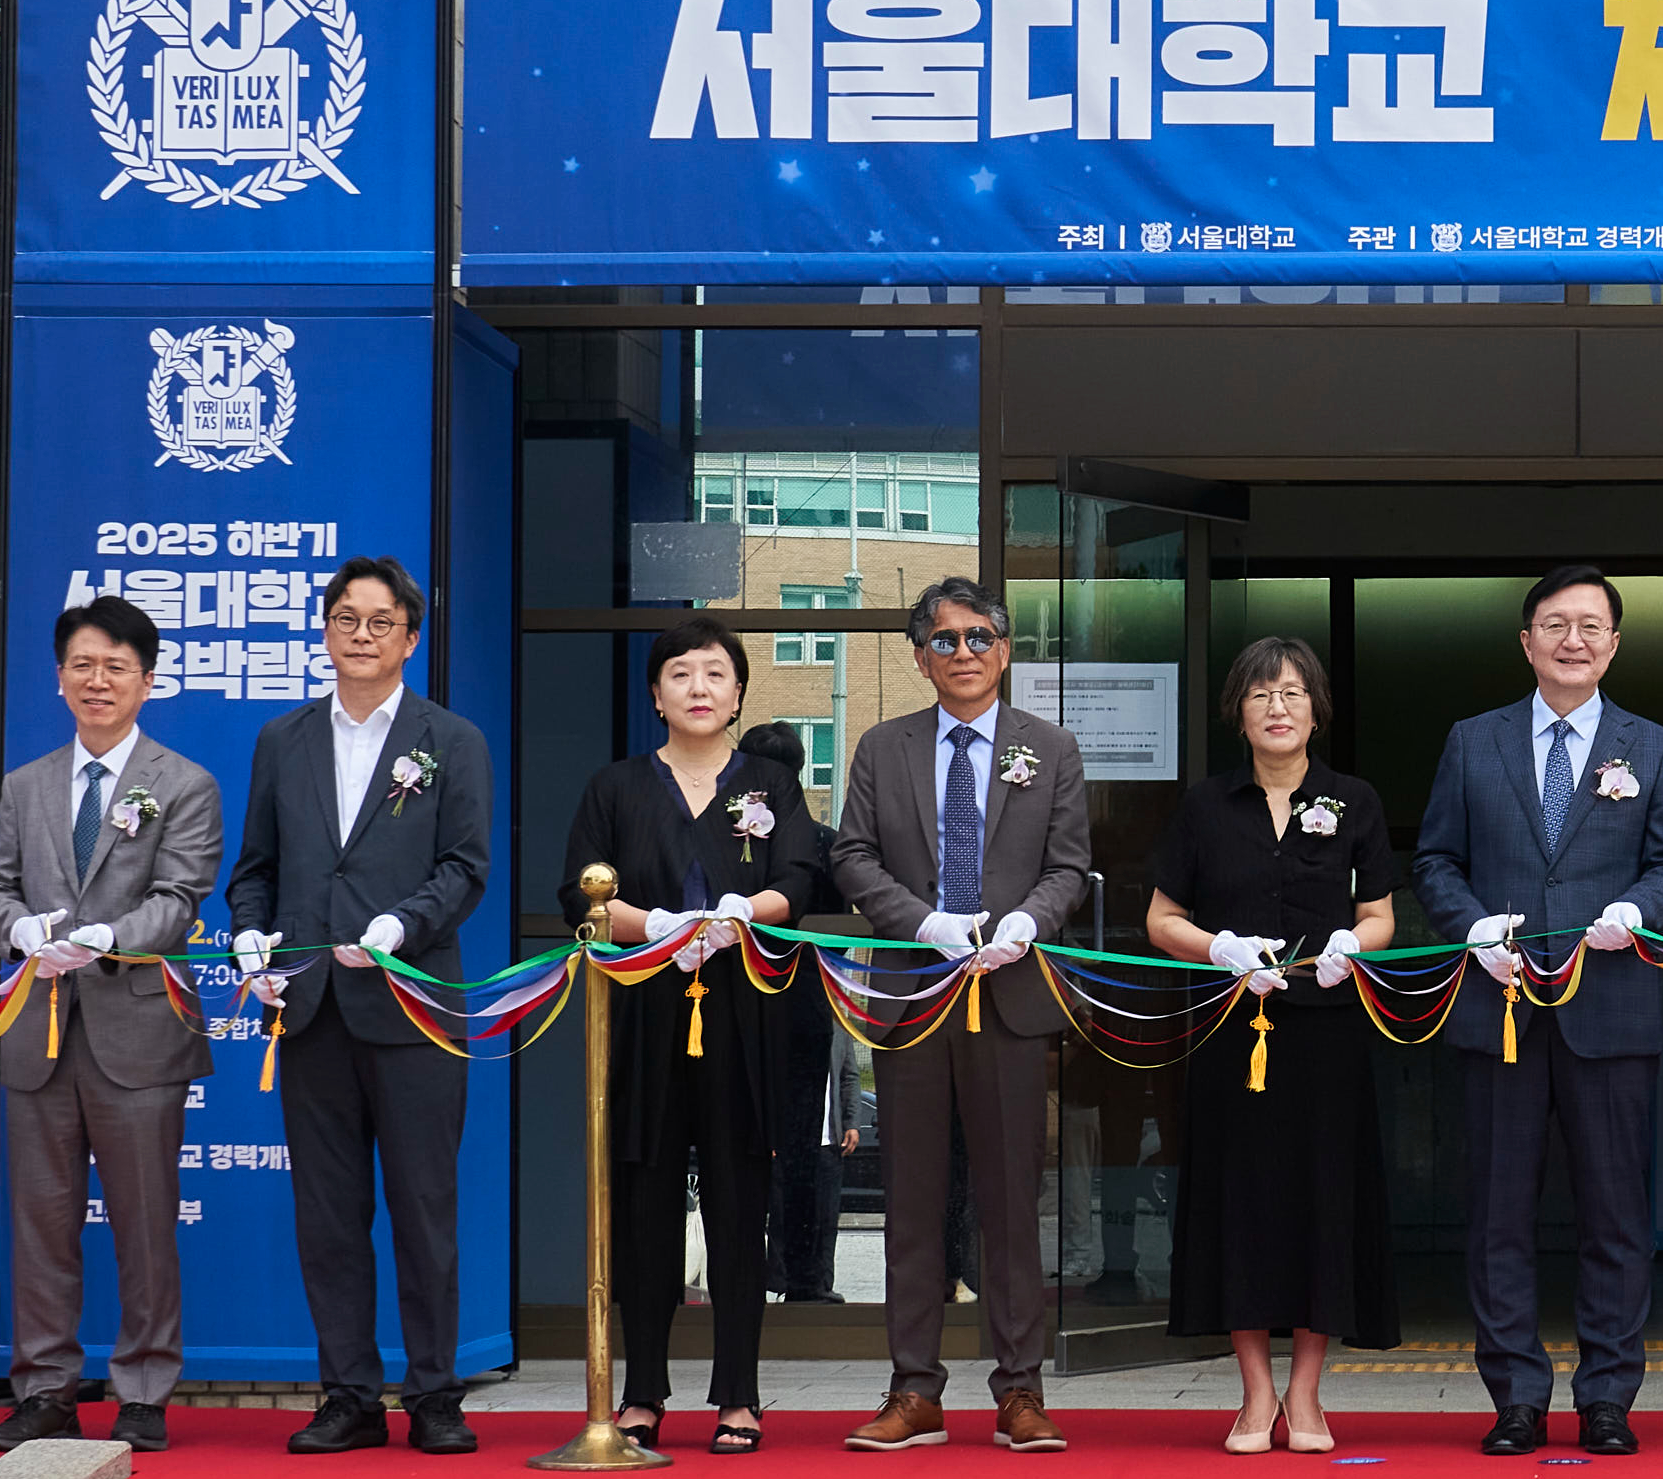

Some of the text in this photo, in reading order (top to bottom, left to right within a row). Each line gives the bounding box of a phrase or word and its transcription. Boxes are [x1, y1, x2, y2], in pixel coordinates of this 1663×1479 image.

[172, 75, 280, 100] VERI LUX
[175, 104, 284, 129] TAS MEA
[1057, 224, 1104, 250] 주최
[1177, 224, 1296, 250] 서울대학교
[1347, 225, 1396, 251] 주관
[1470, 225, 1589, 250] 서울대학교
[193, 401, 250, 414] VERI LUX
[194, 416, 253, 430] TAS MEA
[97, 521, 337, 558] 2025 하반기
